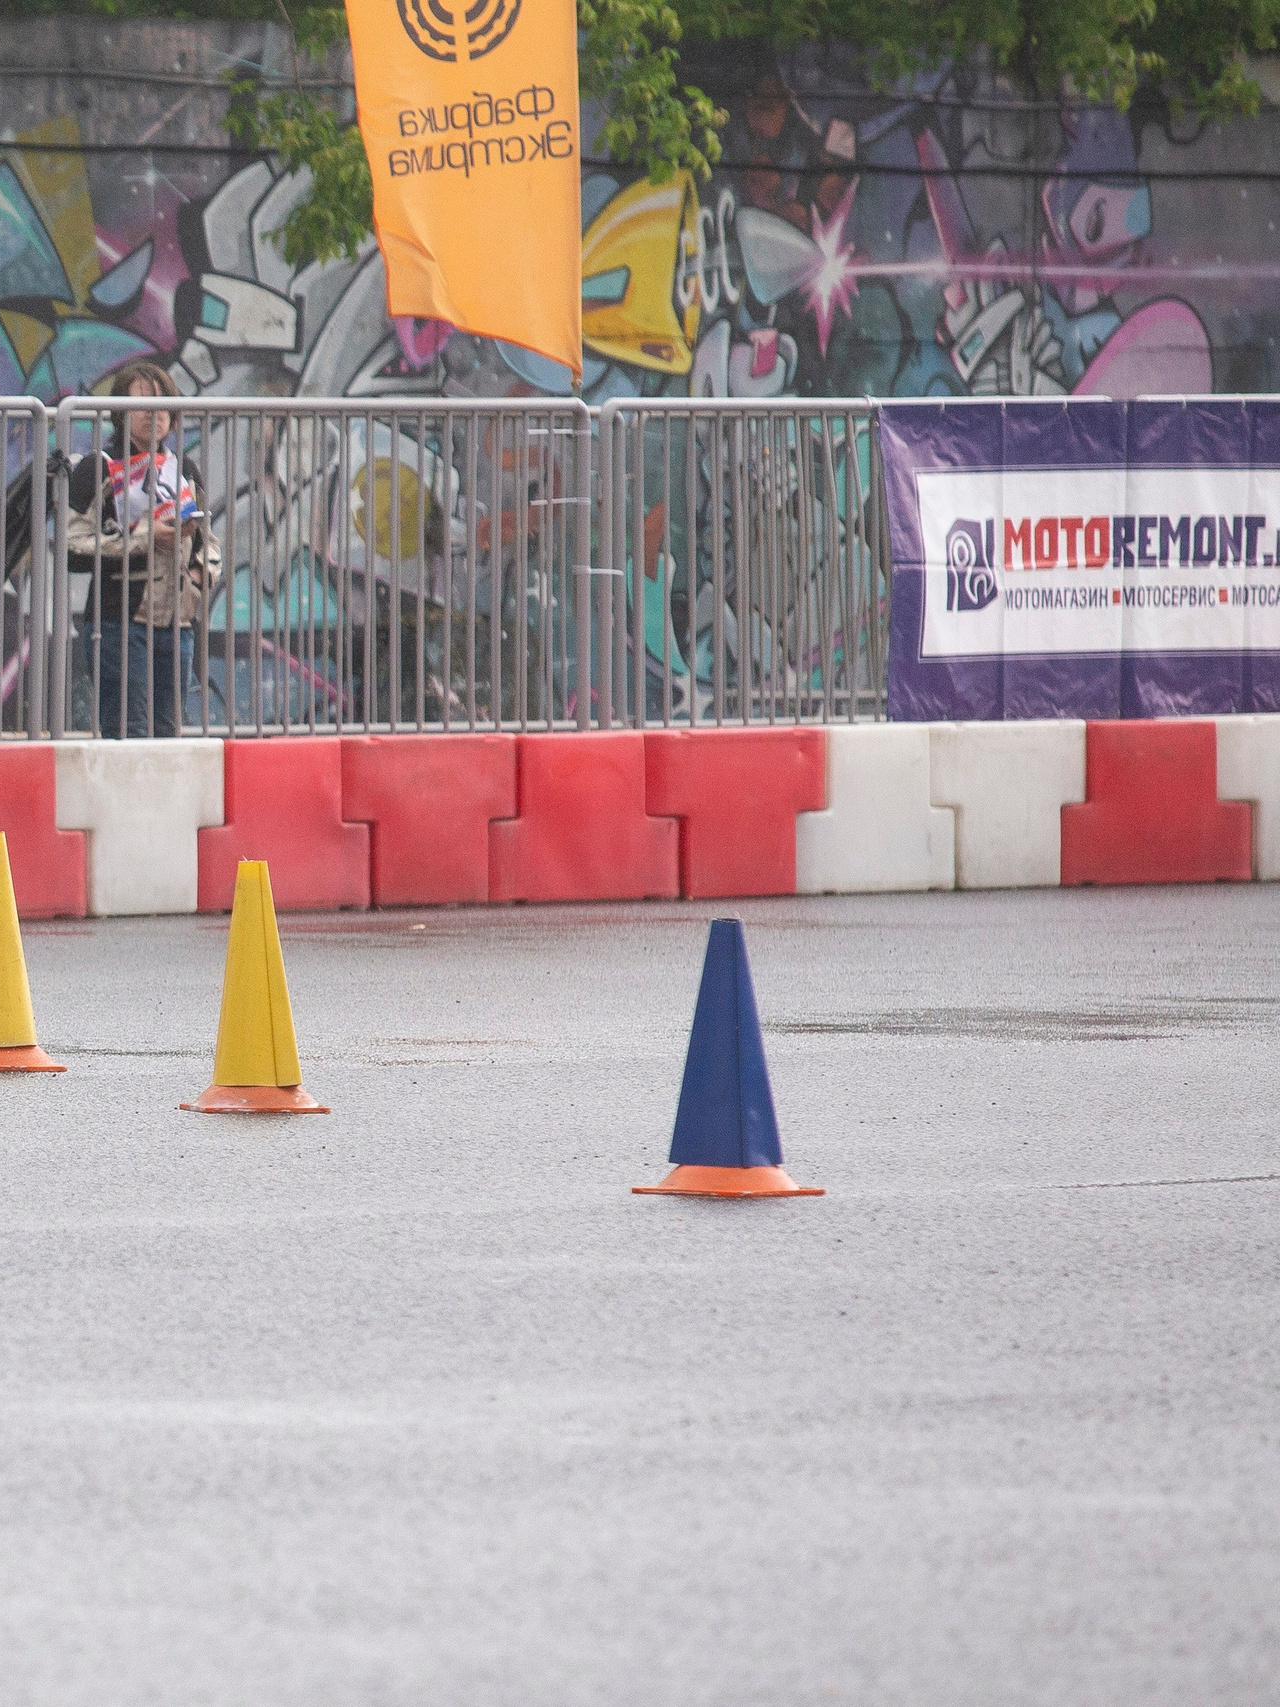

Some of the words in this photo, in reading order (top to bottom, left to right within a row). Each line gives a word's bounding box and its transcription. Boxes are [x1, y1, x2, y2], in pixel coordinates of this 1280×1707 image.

[1003, 516, 1280, 571] MOTOREMONT.
[1005, 587, 1109, 610] МОТОМАГАЗИН
[1123, 585, 1216, 608] МОТОСЕРВИС
